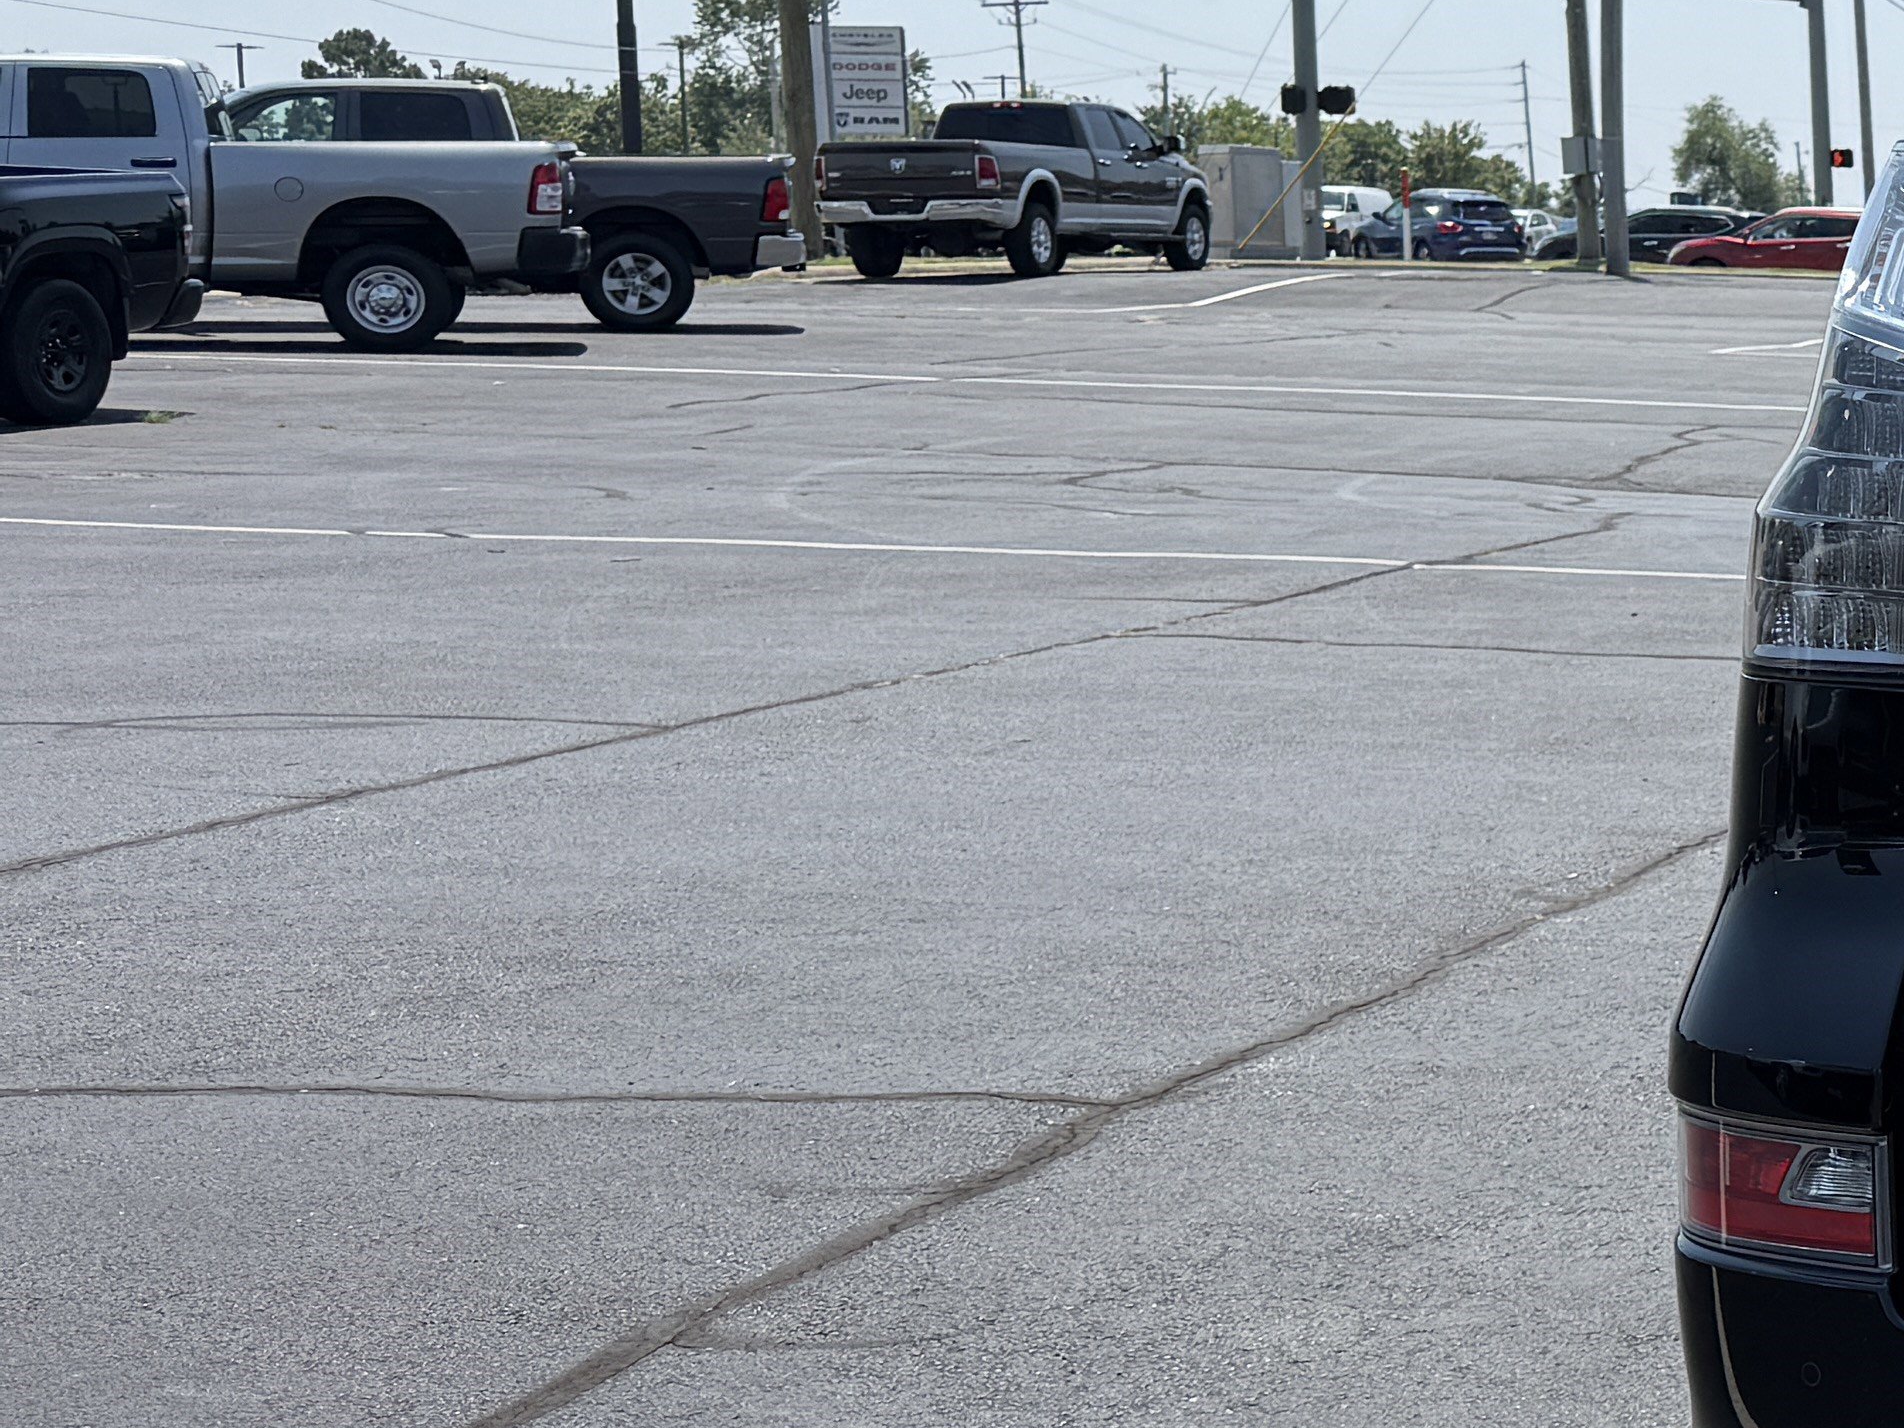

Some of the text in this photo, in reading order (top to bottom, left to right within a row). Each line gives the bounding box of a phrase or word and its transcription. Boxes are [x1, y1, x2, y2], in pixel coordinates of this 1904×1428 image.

[832, 62, 897, 71] DODGE
[842, 84, 888, 103] Jeep
[853, 116, 900, 125] RAM
